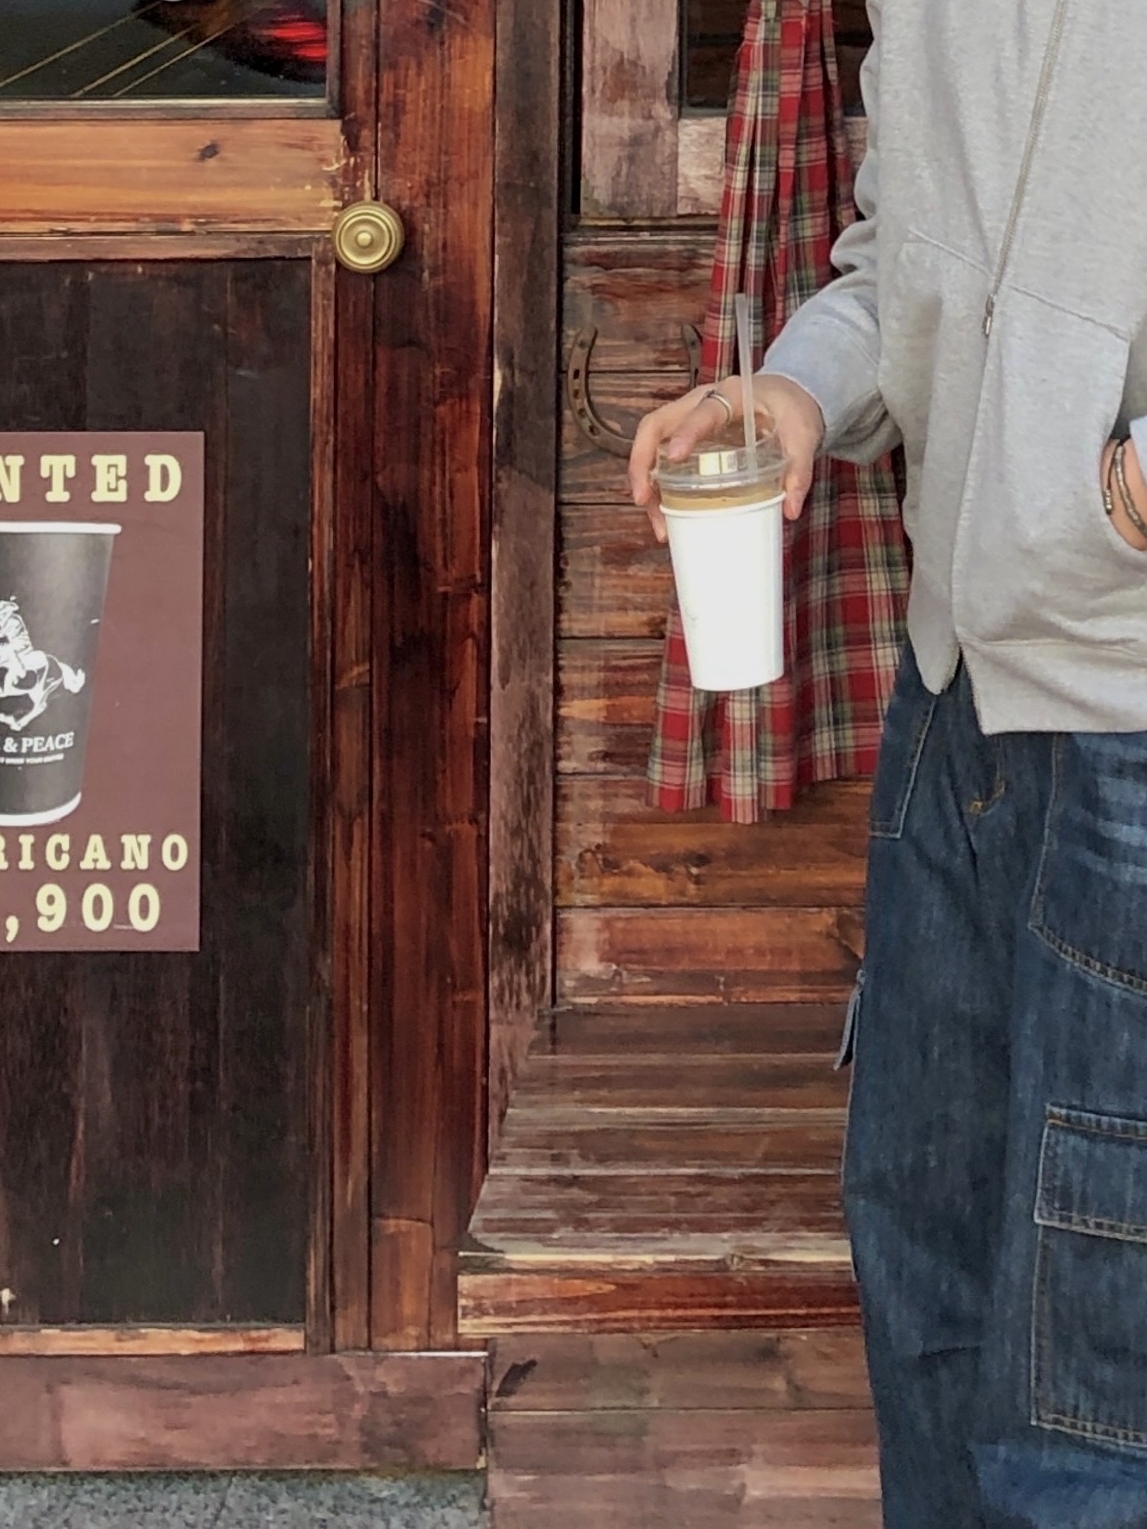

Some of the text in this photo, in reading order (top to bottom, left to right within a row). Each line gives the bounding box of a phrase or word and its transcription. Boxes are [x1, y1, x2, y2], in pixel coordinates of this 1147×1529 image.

[3, 731, 75, 753] & PEACE
[0, 834, 188, 870] ICANO
